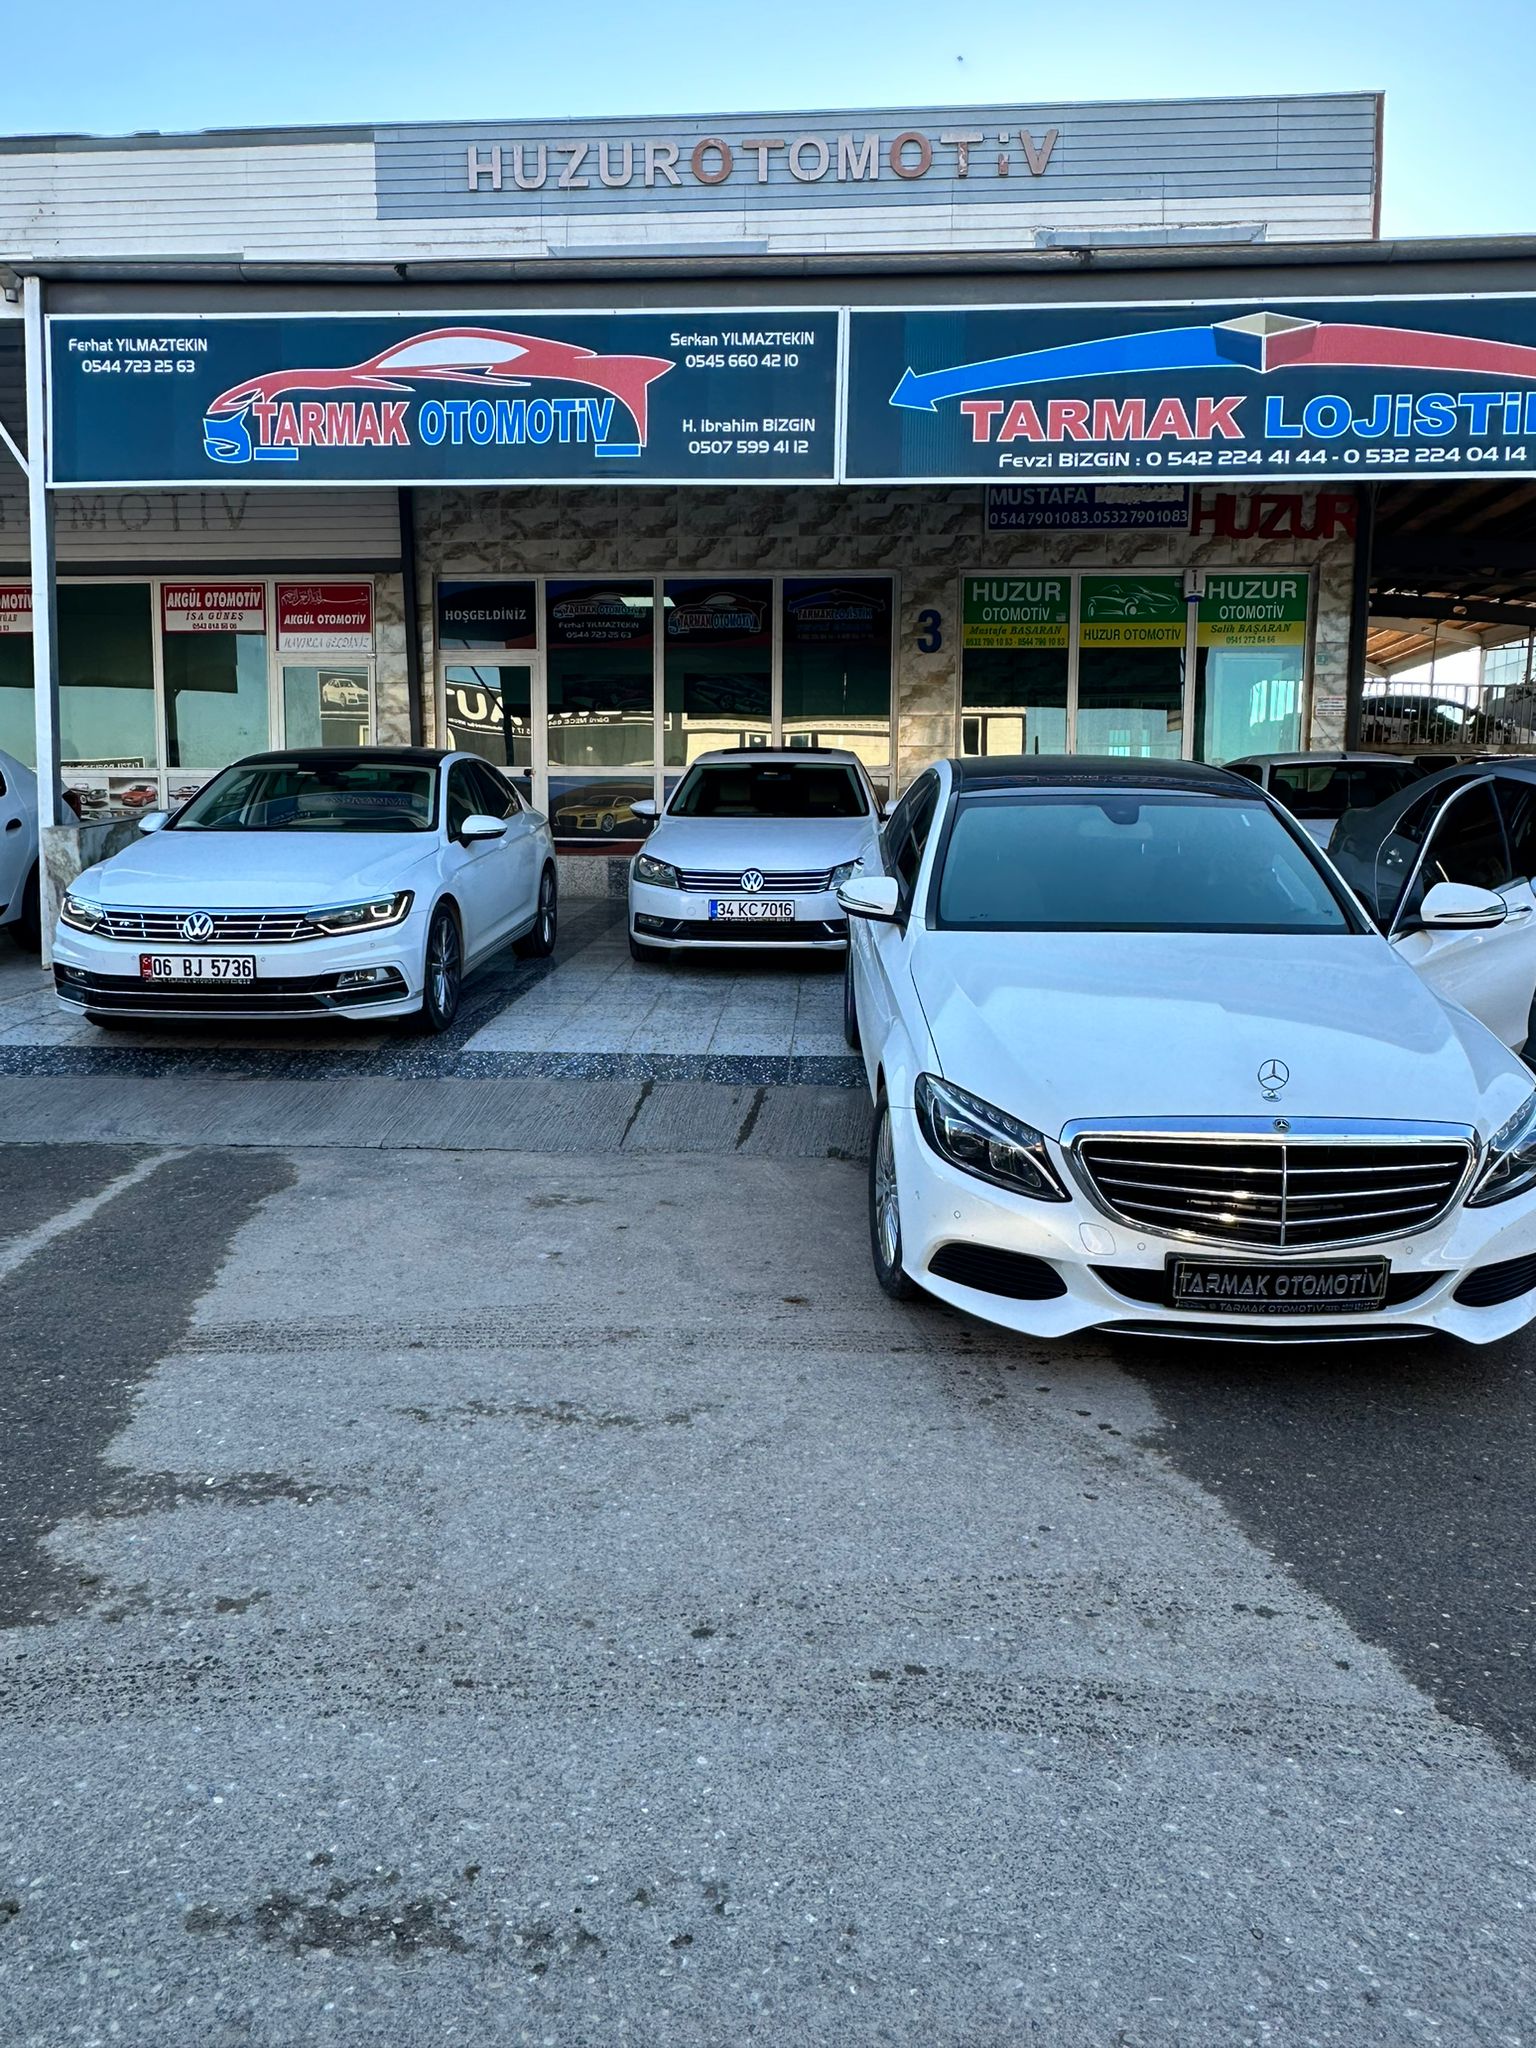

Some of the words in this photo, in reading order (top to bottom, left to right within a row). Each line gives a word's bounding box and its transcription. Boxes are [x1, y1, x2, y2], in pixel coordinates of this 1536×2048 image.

[68, 338, 114, 352] Ferhat
[670, 332, 718, 346] Serkan
[82, 360, 122, 373] 0544
[124, 360, 152, 373] 723
[154, 360, 174, 373] 25
[176, 360, 196, 373] 63
[685, 354, 725, 368] 0545
[728, 354, 758, 368] 660
[761, 354, 781, 367] 42
[784, 354, 799, 367] 10
[252, 401, 410, 447] TARMAK
[682, 419, 697, 433] H.
[960, 396, 1247, 443] TARMAK
[688, 441, 733, 454] 0507
[736, 441, 770, 454] 599
[773, 440, 789, 454] 41
[793, 440, 809, 454] 12
[998, 453, 1052, 468] Fevzi
[1146, 452, 1162, 467] 0
[1167, 451, 1212, 466] 542
[1218, 450, 1262, 465] 224
[1268, 449, 1290, 464] 41
[1295, 449, 1328, 464] 44
[1343, 448, 1360, 464] 0
[1365, 448, 1410, 464] 532
[1414, 447, 1460, 463] 224
[1466, 446, 1499, 462] 04
[1505, 446, 1527, 462] 14
[989, 486, 1089, 506] MUSTAFA
[1190, 492, 1357, 540] HUZUR
[167, 587, 202, 608] AKGÜL
[972, 581, 1062, 602] HUZUR
[1208, 580, 1297, 600] HUZUR
[284, 611, 315, 625] AKGÜL
[445, 606, 527, 624] HOŞGELDİNİZ
[917, 608, 942, 654] 3
[1083, 629, 1121, 642] HUZUR
[1210, 623, 1236, 634] Salih
[718, 902, 734, 916] 34
[738, 902, 758, 916] KC
[761, 902, 793, 916] 7016
[153, 958, 172, 976] 06
[183, 958, 203, 977] BJ
[211, 959, 252, 977] 5736
[1179, 1272, 1269, 1296] TARMAK
[1219, 1302, 1265, 1313] TARMAK
